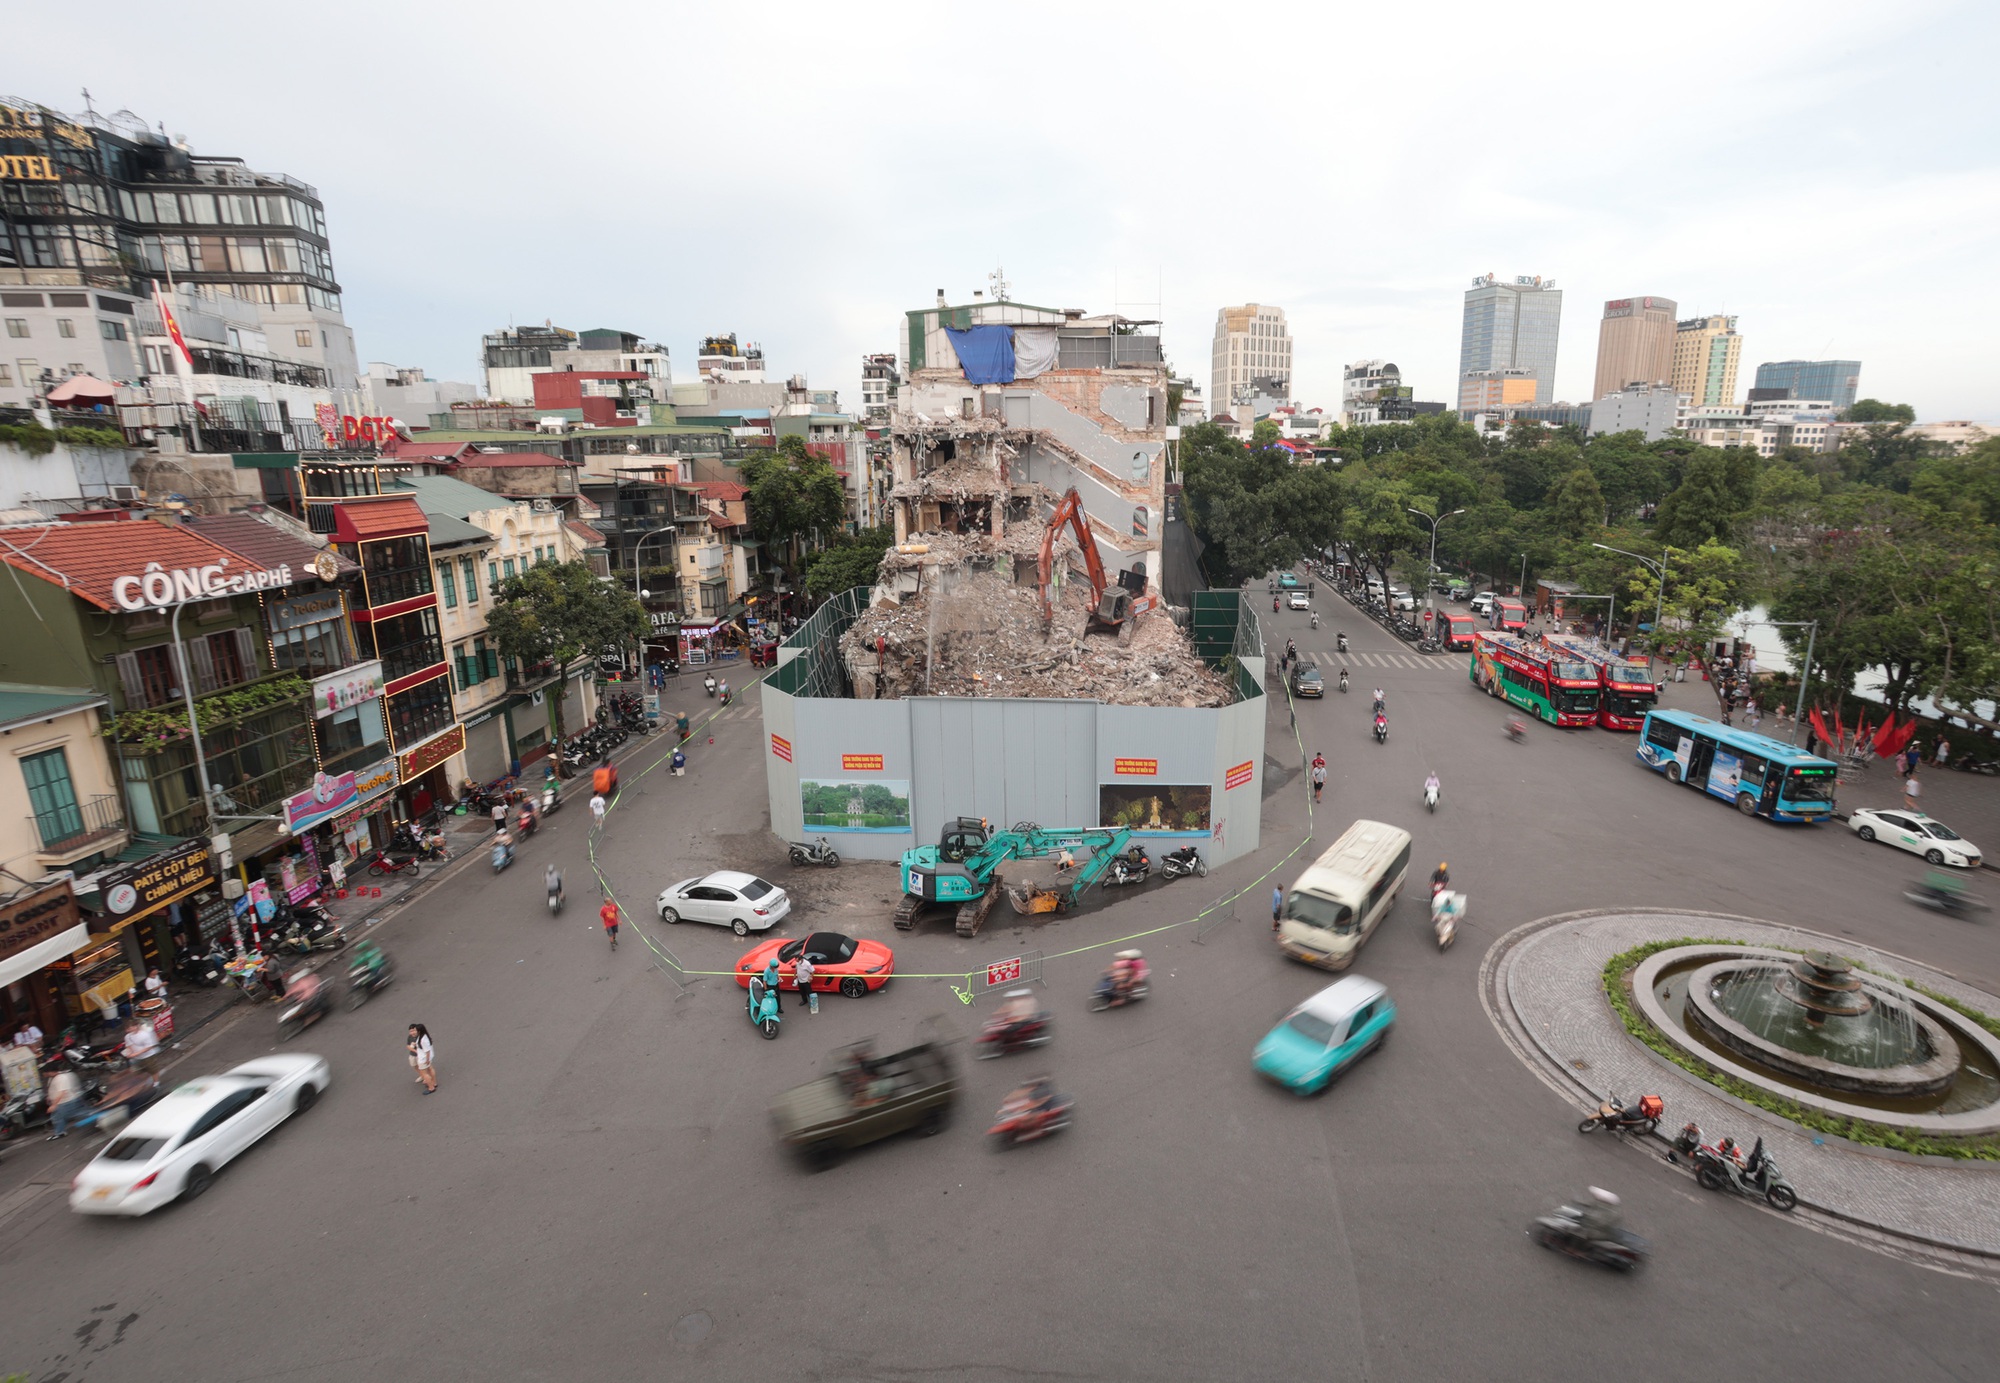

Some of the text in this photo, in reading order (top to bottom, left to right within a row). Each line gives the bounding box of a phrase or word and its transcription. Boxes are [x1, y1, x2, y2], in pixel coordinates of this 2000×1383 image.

[1605, 309, 1630, 318] GROUP
[343, 415, 396, 442] DGTS
[112, 562, 228, 614] CỘNG
[650, 611, 676, 626] AFA
[600, 654, 620, 663] SPA
[134, 871, 163, 890] PATE
[163, 860, 186, 876] CỘT
[145, 866, 204, 902] CHÍNH HIỆU
